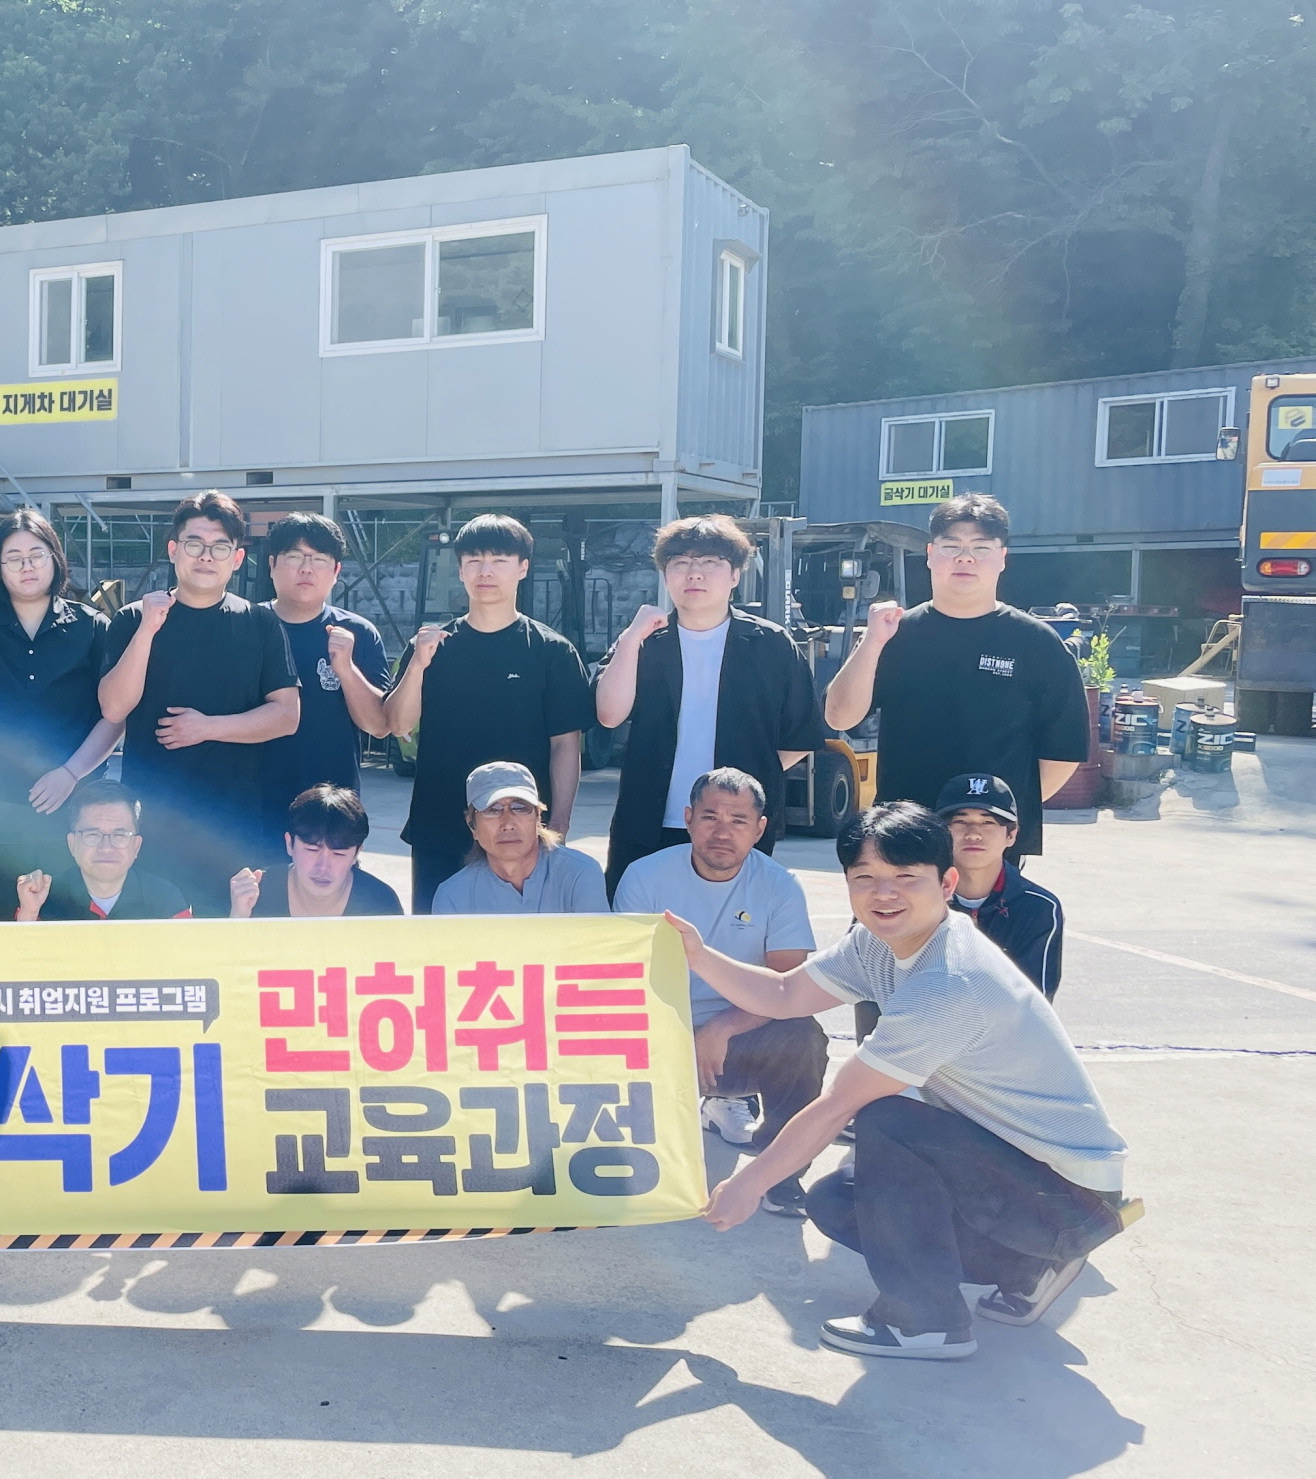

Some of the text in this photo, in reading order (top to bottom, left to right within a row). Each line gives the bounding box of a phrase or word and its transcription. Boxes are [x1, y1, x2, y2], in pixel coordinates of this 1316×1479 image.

[1, 388, 113, 415] 지게차 대기실
[884, 485, 950, 501] 굴삭기 대기실
[1114, 712, 1148, 727] ZIC
[1197, 732, 1234, 746] ZIC
[18, 986, 110, 1015] 취업지원
[115, 985, 207, 1014] 프로그램
[257, 961, 650, 1073] 면허취득
[264, 1081, 661, 1197] 교육과정
